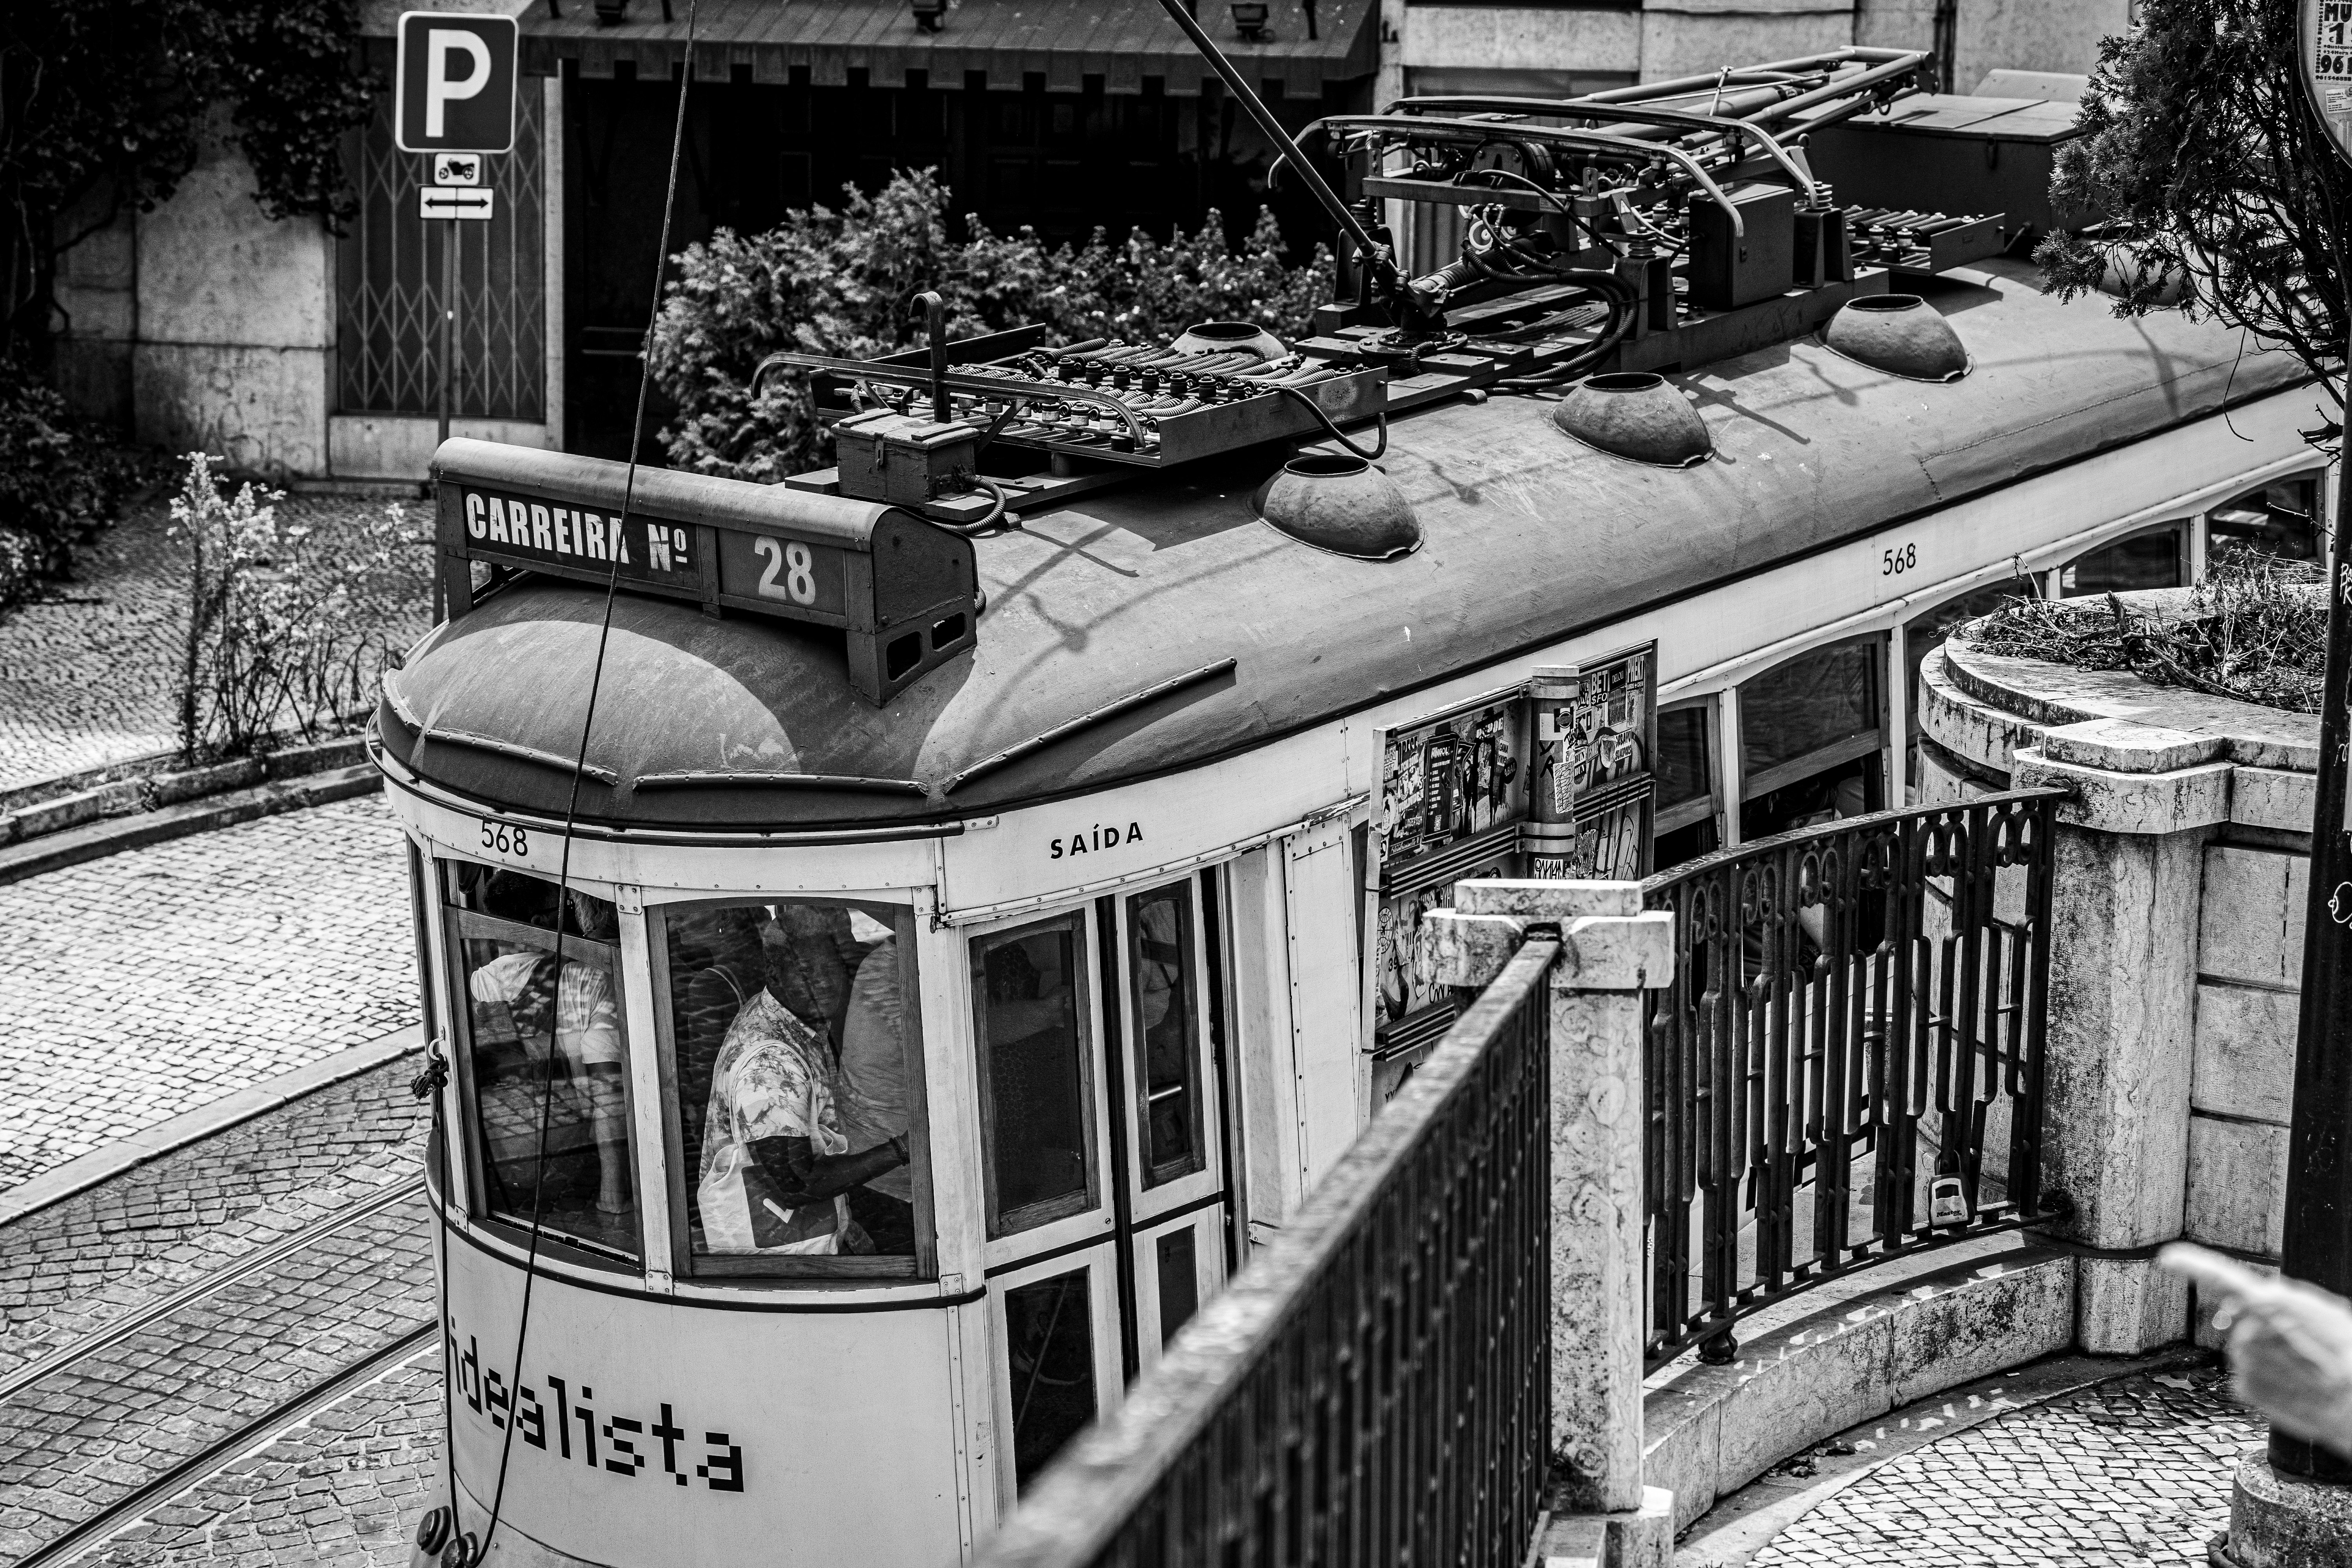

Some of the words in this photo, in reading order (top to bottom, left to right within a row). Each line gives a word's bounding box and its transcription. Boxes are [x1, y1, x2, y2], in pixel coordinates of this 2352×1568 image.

[426, 29, 491, 138] P
[465, 493, 629, 565] CARREIRA
[753, 535, 816, 605] 28
[1883, 543, 1916, 575] 568
[1591, 670, 1608, 695] BET
[481, 820, 528, 857] 568
[1051, 822, 1143, 859] SAÍDA
[450, 1315, 744, 1493] idealista
